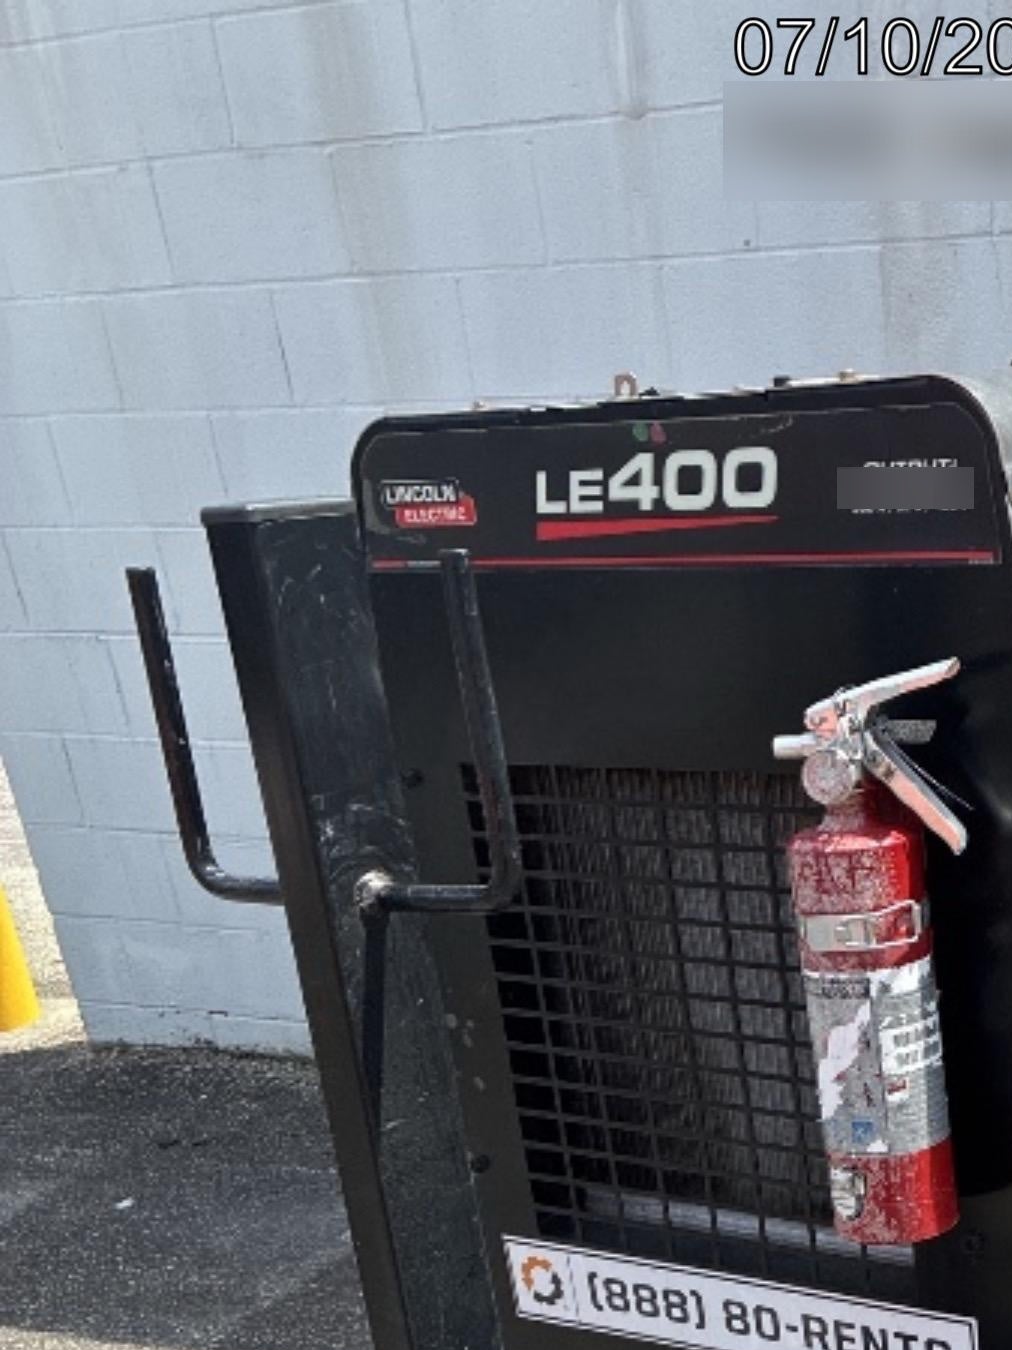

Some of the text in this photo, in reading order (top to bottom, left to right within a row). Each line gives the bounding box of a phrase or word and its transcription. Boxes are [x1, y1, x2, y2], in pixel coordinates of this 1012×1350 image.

[385, 484, 458, 504] LINCOLN
[535, 446, 778, 515] LE400
[403, 506, 467, 522] ELECTRIC
[587, 1271, 707, 1330] (888)
